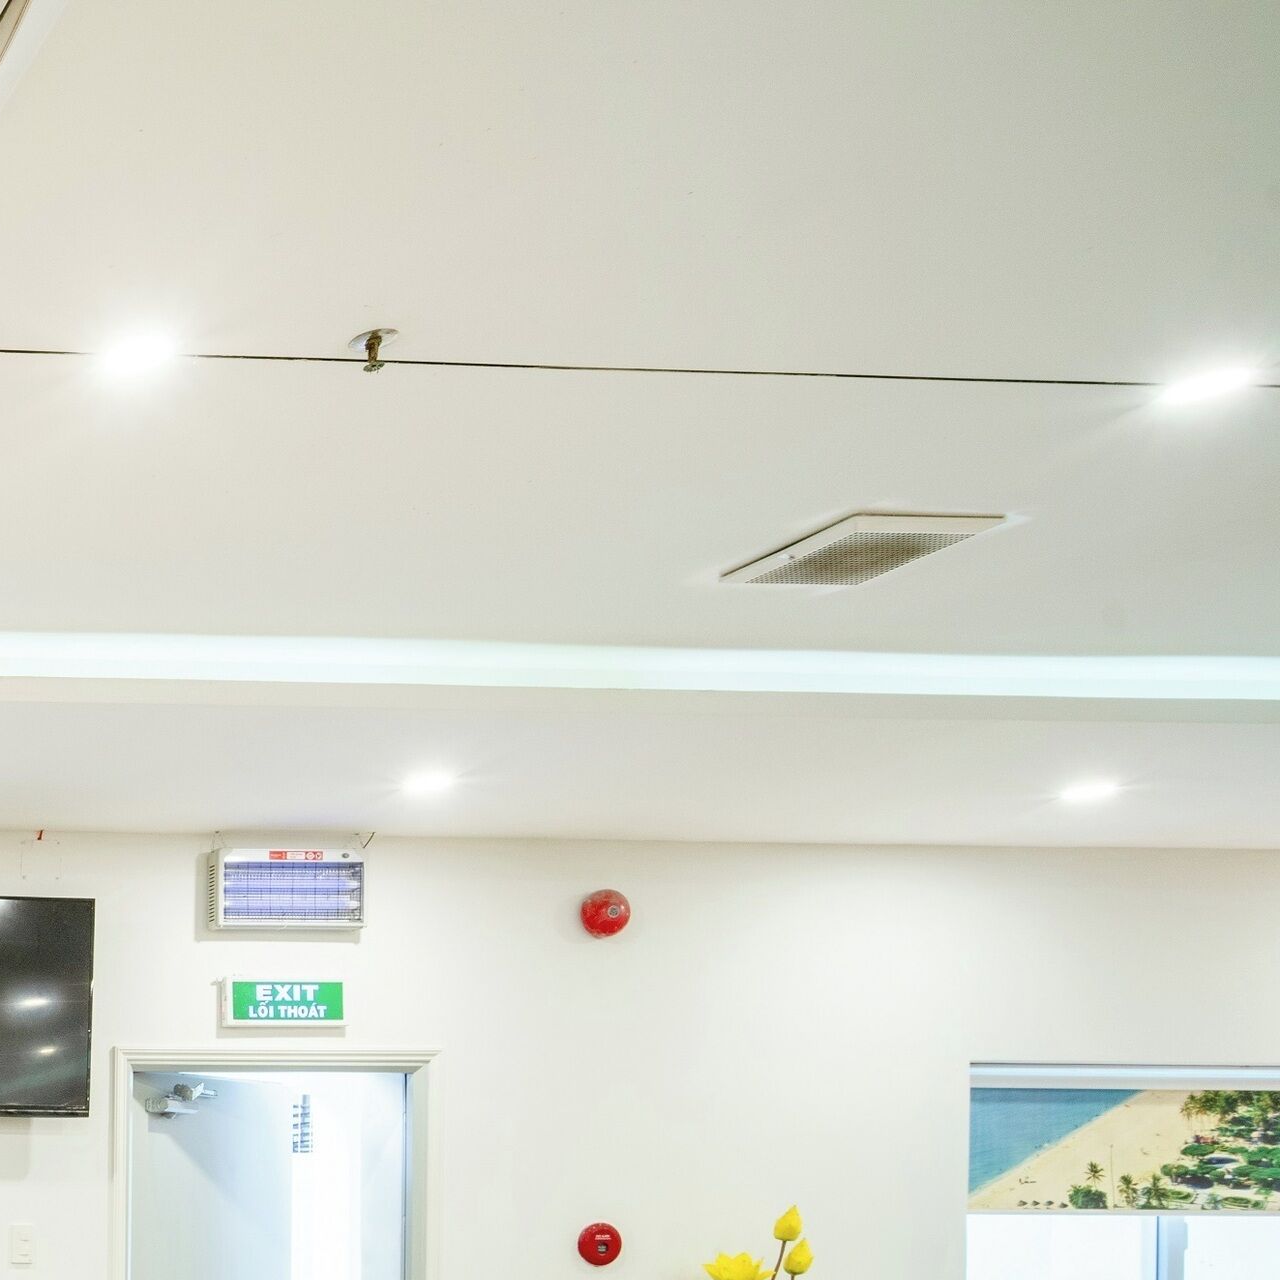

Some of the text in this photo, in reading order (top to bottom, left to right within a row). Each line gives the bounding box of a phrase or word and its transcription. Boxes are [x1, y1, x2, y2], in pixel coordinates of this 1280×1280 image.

[255, 984, 319, 1001] EXIT
[248, 1000, 327, 1018] LỐI THOÁT
